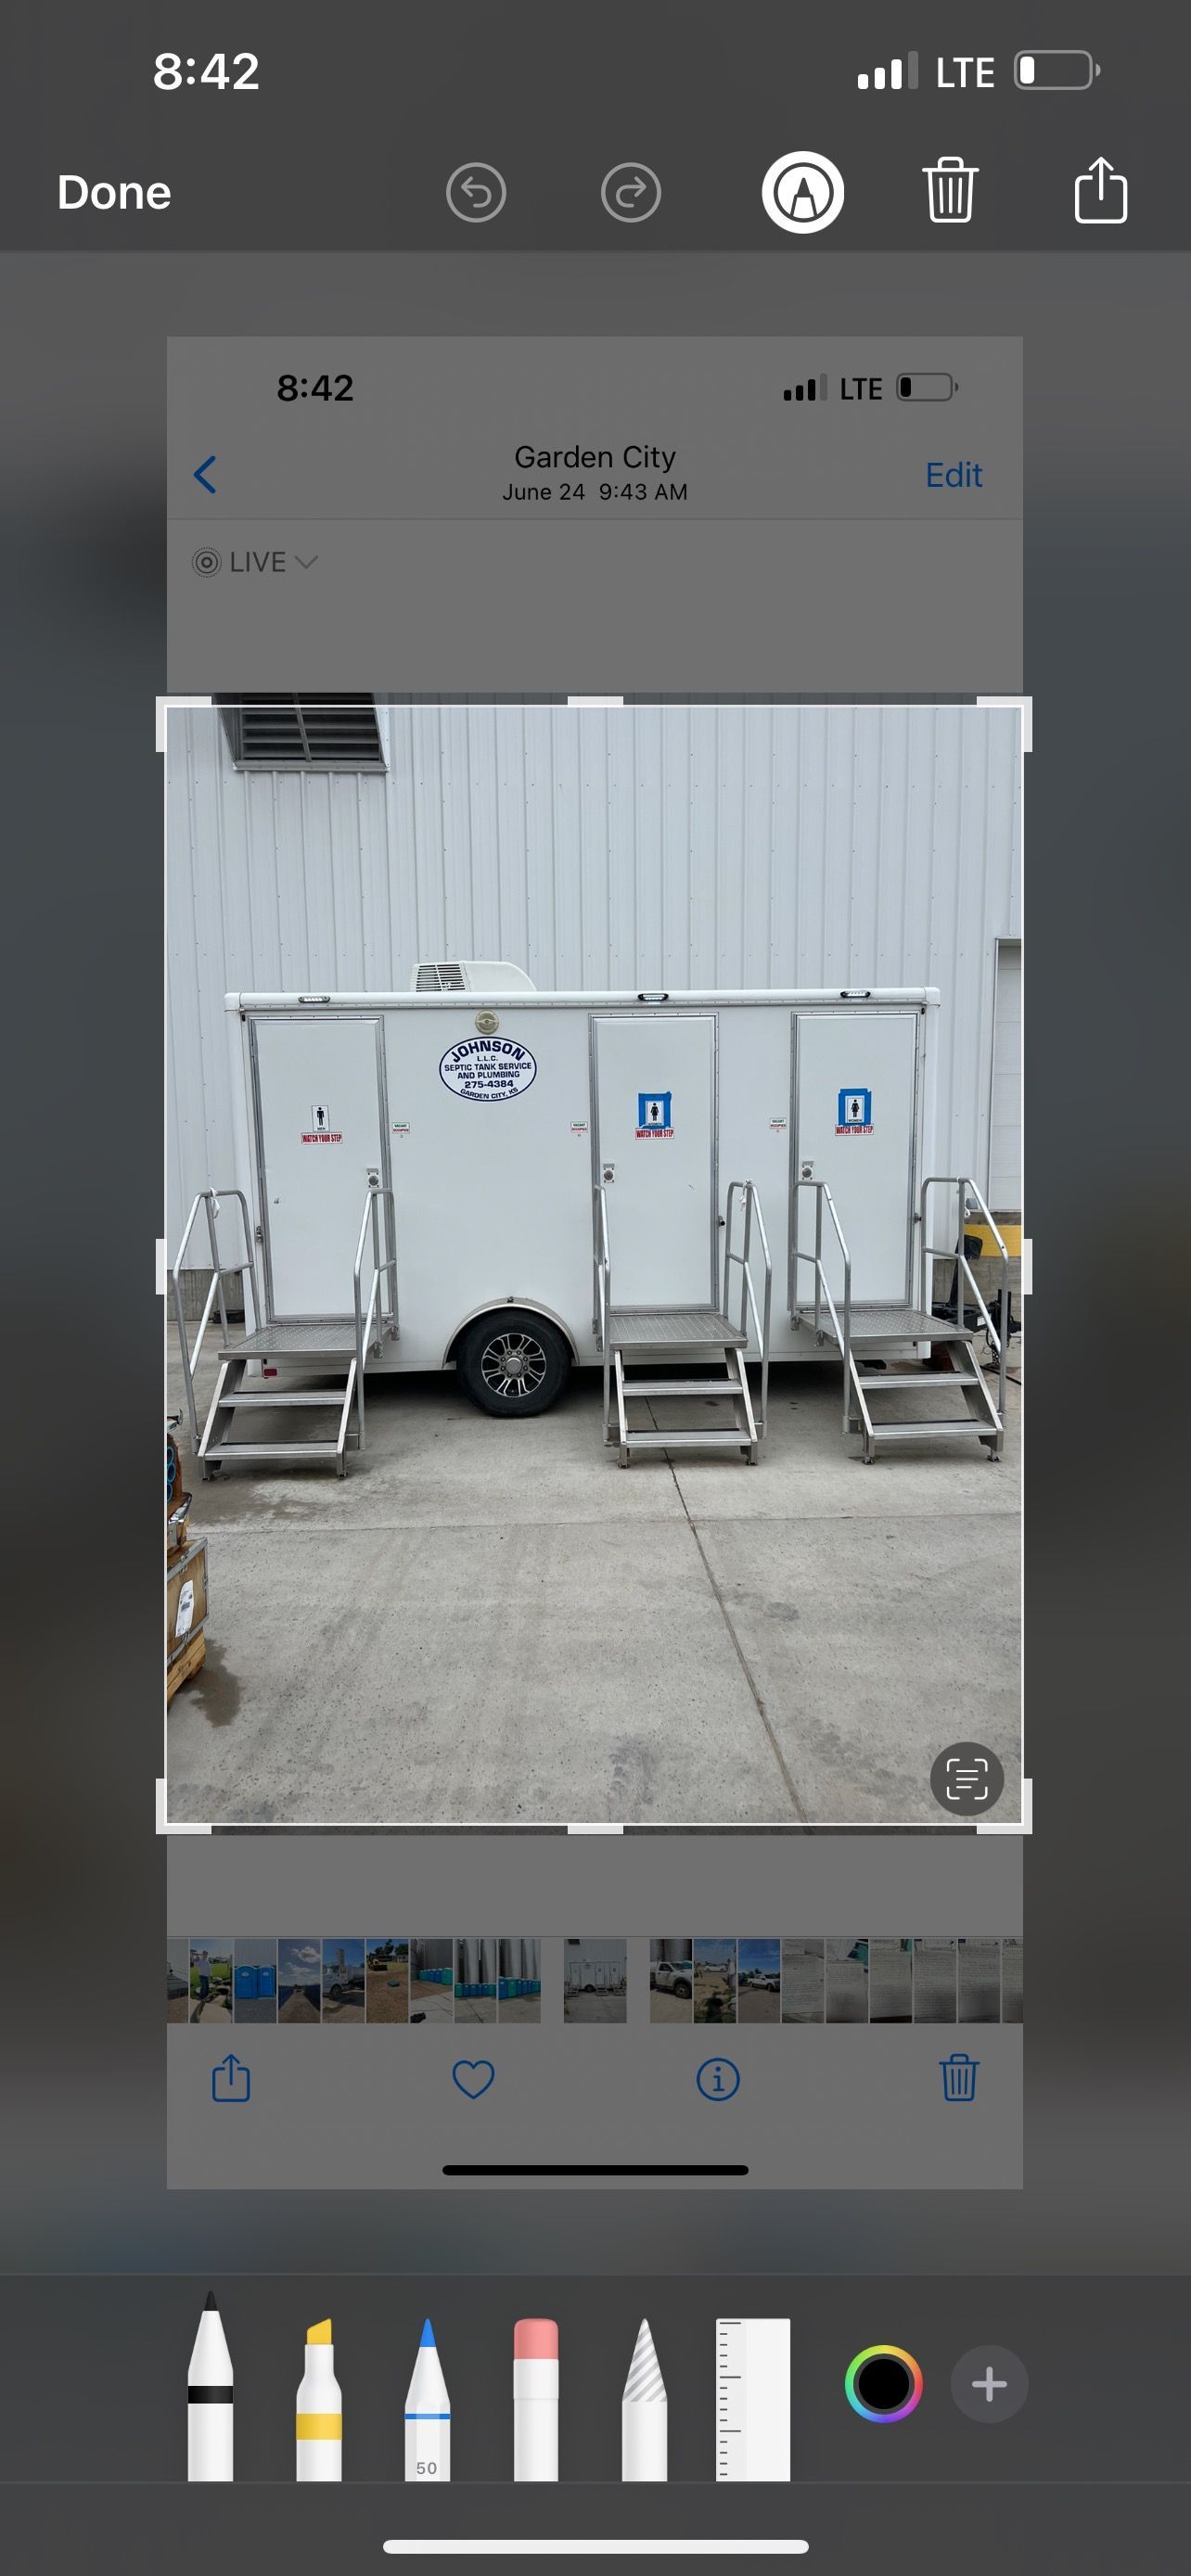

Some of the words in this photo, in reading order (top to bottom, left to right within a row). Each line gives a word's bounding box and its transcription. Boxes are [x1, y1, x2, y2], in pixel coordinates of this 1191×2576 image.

[154, 53, 260, 90] 8:42
[937, 57, 995, 88] LTE
[58, 174, 172, 210] Done
[276, 374, 353, 402] 8:42
[840, 377, 883, 401] LTE
[515, 444, 613, 469] Garden
[623, 444, 677, 474] City
[927, 461, 983, 488] Edit
[502, 482, 552, 501] June
[559, 482, 586, 501] 24
[599, 482, 647, 501] 9:43
[654, 482, 687, 501] AM
[230, 551, 287, 573] LIVE
[452, 1039, 525, 1063] JOHNSON
[498, 1062, 531, 1070] SERVICE
[460, 1088, 489, 1099] GARDEN
[508, 1087, 519, 1095] KS
[465, 1080, 514, 1089] 275-4384
[302, 1134, 319, 1143] WATCH
[319, 1134, 331, 1143] YOUR
[331, 1133, 342, 1142] STEP
[636, 1129, 652, 1139] WATCH
[652, 1129, 663, 1139] YOUR
[663, 1129, 674, 1138] STEP
[836, 1126, 851, 1134] WATCH
[852, 1126, 863, 1134] YOUR
[863, 1125, 873, 1133] STEP
[416, 2461, 438, 2475] 50
